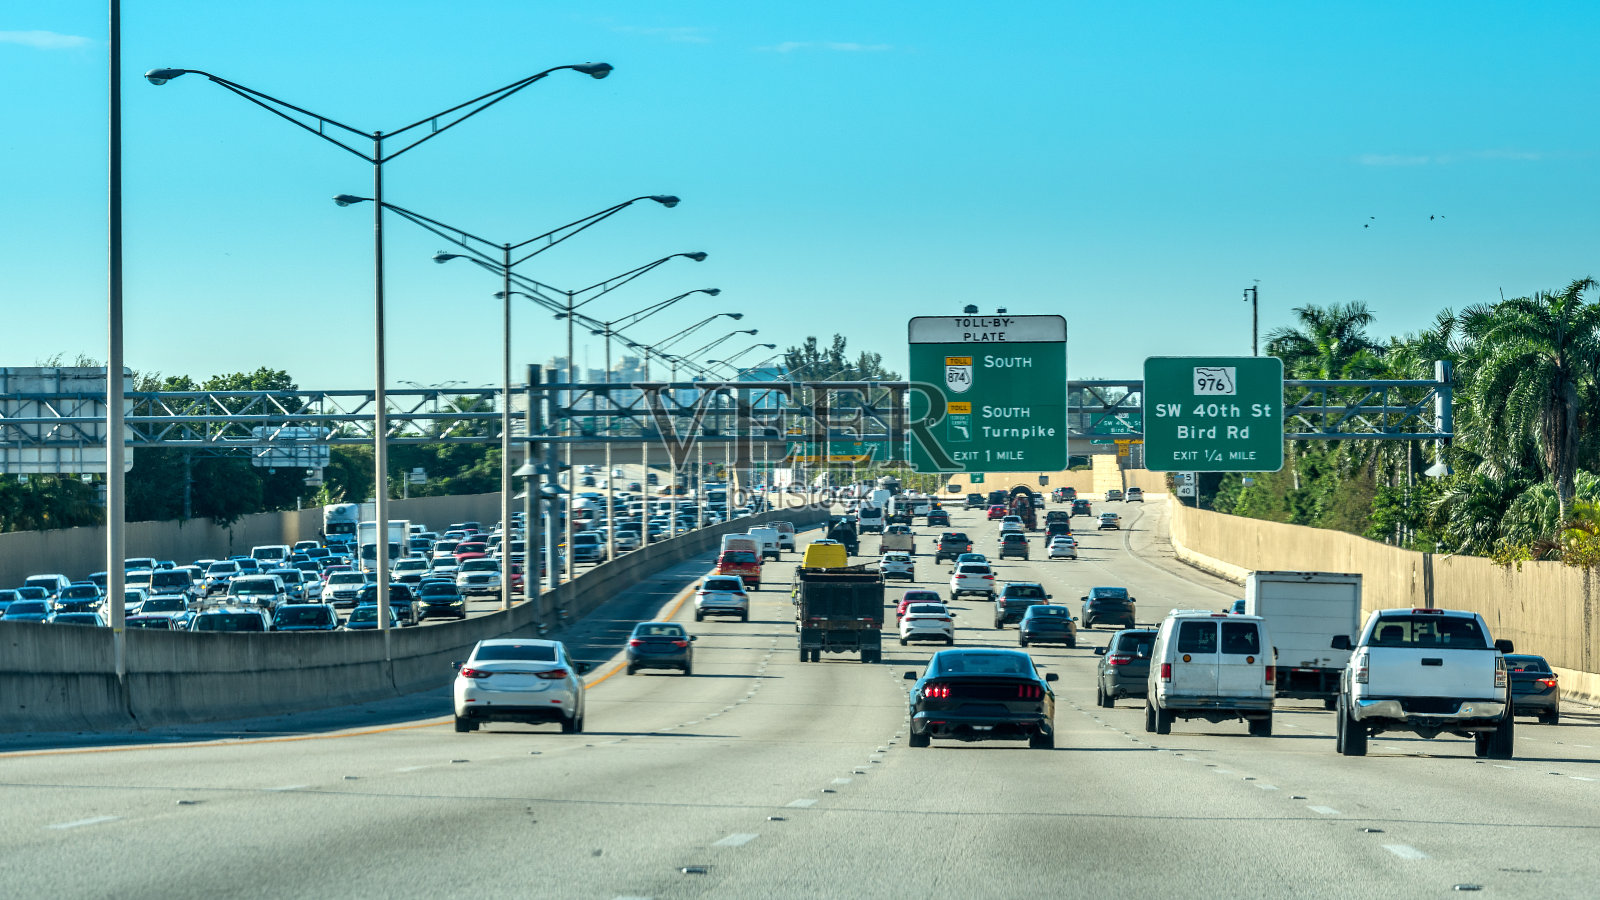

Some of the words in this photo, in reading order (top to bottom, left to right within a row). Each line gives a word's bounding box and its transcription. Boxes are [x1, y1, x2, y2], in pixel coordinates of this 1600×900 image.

[955, 318, 1015, 327] TOLL-BY-
[963, 332, 1006, 341] PLATE
[983, 355, 1032, 368] SOUTH
[948, 372, 966, 383] 874
[1198, 378, 1225, 391] 976
[982, 405, 1030, 418] SOUTH
[1155, 403, 1182, 418] SW
[1192, 403, 1241, 418] 40th
[1251, 403, 1272, 418] St
[982, 426, 1056, 439] Turnpike
[1177, 425, 1217, 439] Bird
[1226, 425, 1250, 439] Rd
[953, 451, 979, 461] EXIT
[985, 450, 991, 462] 1
[996, 450, 1024, 460] MILE
[1173, 451, 1198, 461] EXIT
[1229, 451, 1257, 461] MILE
